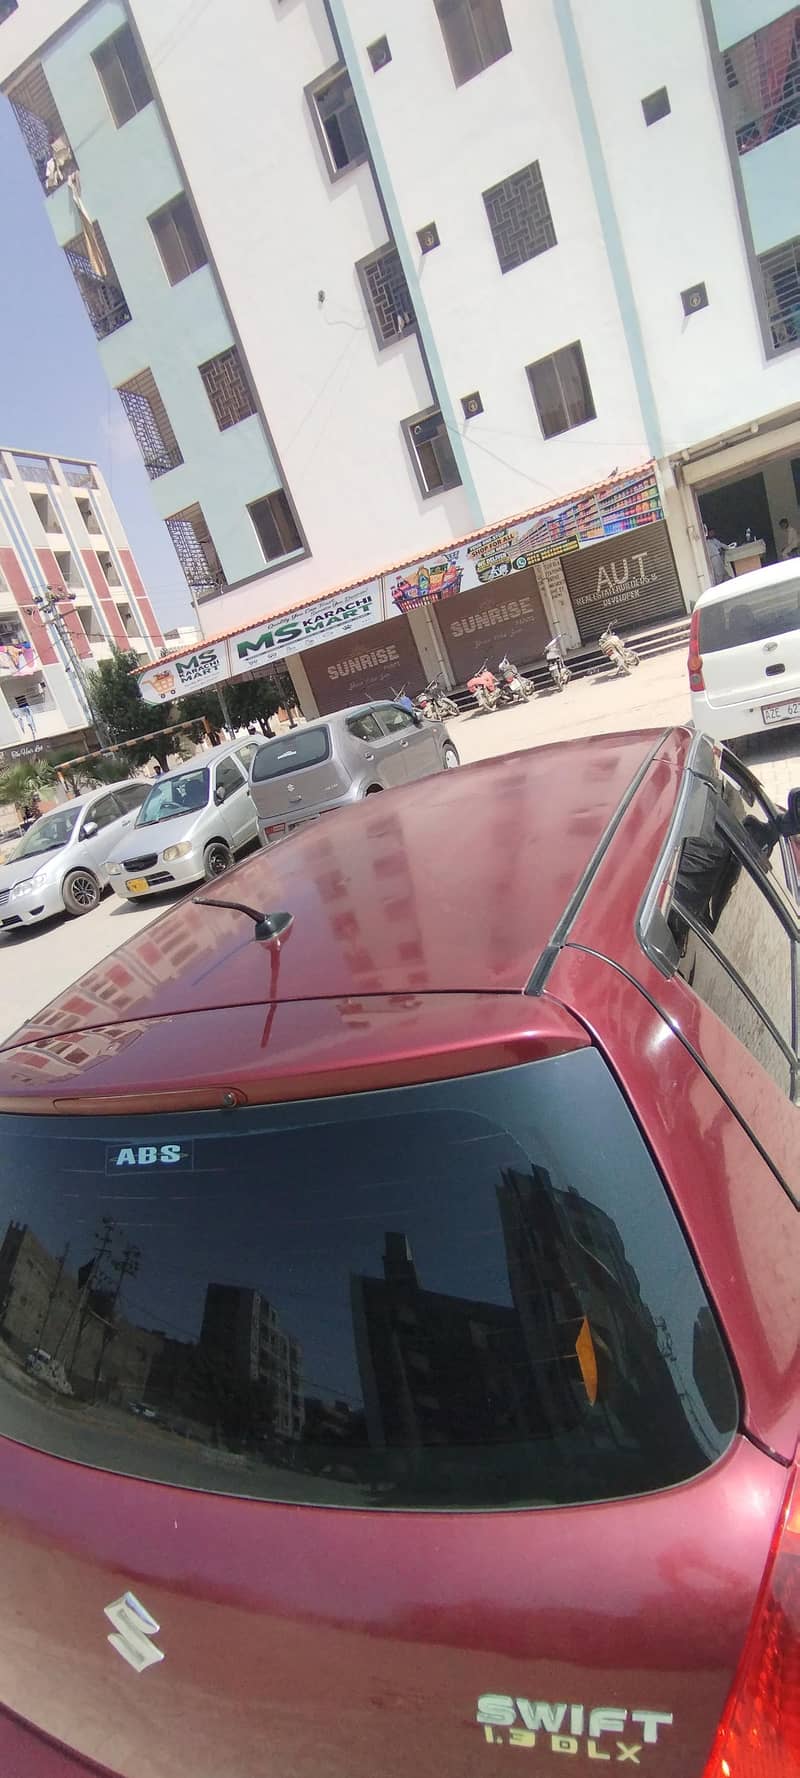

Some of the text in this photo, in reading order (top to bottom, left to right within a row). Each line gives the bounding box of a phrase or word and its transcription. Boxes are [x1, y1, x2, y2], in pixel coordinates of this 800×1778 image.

[471, 545, 488, 557] SHOP
[503, 533, 515, 542] ALL
[302, 596, 373, 627] KARACHI
[305, 603, 373, 634] MART
[450, 597, 534, 638] SUNRISE
[237, 622, 302, 660] MS
[176, 649, 217, 676] MS
[178, 659, 220, 679] KARACHI
[181, 666, 219, 683] MART
[327, 645, 400, 680] SUNRISE
[765, 707, 781, 720] AZE
[116, 1145, 180, 1165] ABS
[476, 1694, 673, 1743] SWIFT
[484, 1725, 642, 1763] 1.3 DLX
